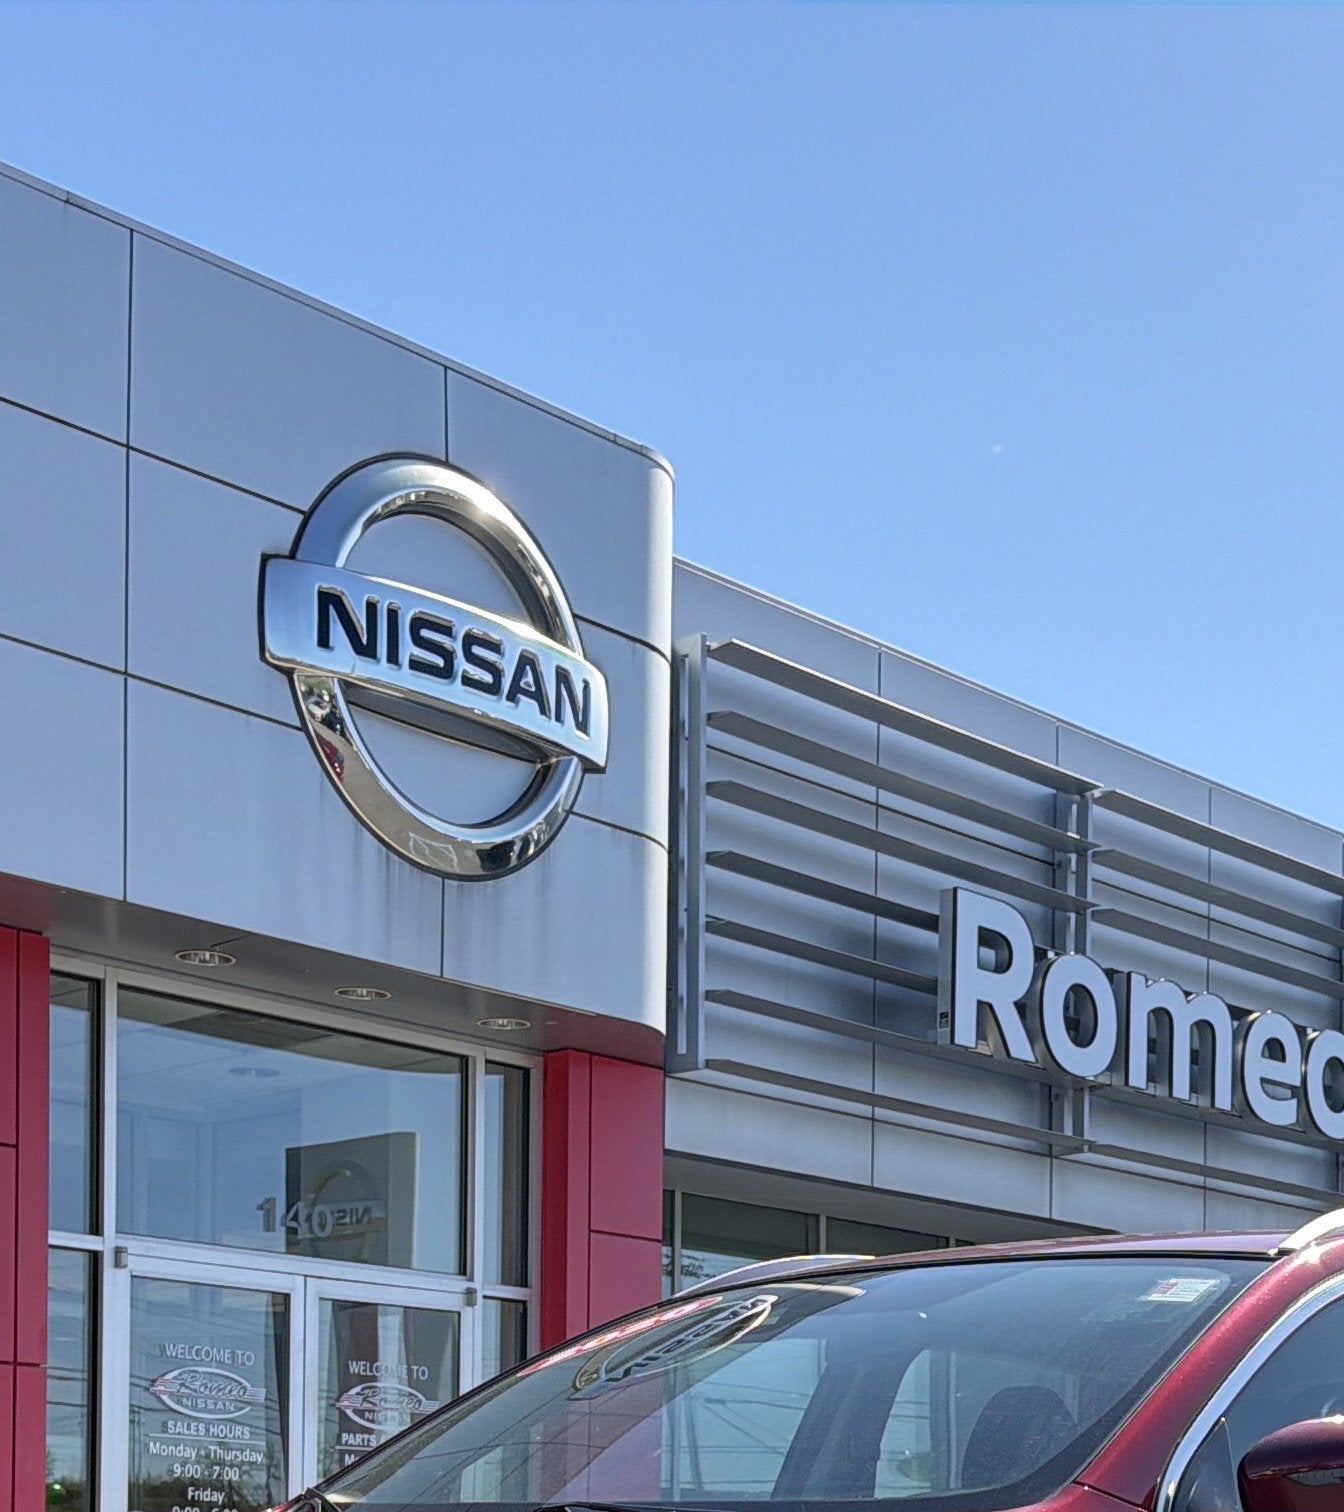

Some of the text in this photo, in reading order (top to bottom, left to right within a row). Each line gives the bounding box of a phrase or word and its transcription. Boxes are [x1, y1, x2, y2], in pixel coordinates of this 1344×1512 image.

[316, 584, 592, 739] NISSAN
[164, 1343, 255, 1366] WELCOME TO
[348, 1360, 429, 1380] WELCOME TO
[177, 1370, 248, 1397] Romeo
[182, 1398, 234, 1411] NISSAN
[167, 1420, 251, 1439] SALES HOURS
[341, 1432, 376, 1446] PARTS
[149, 1441, 197, 1460] Monday
[208, 1445, 264, 1464] Thursday
[173, 1463, 200, 1479] 9:00
[212, 1466, 239, 1480] 7:00
[187, 1486, 225, 1504] Friday
